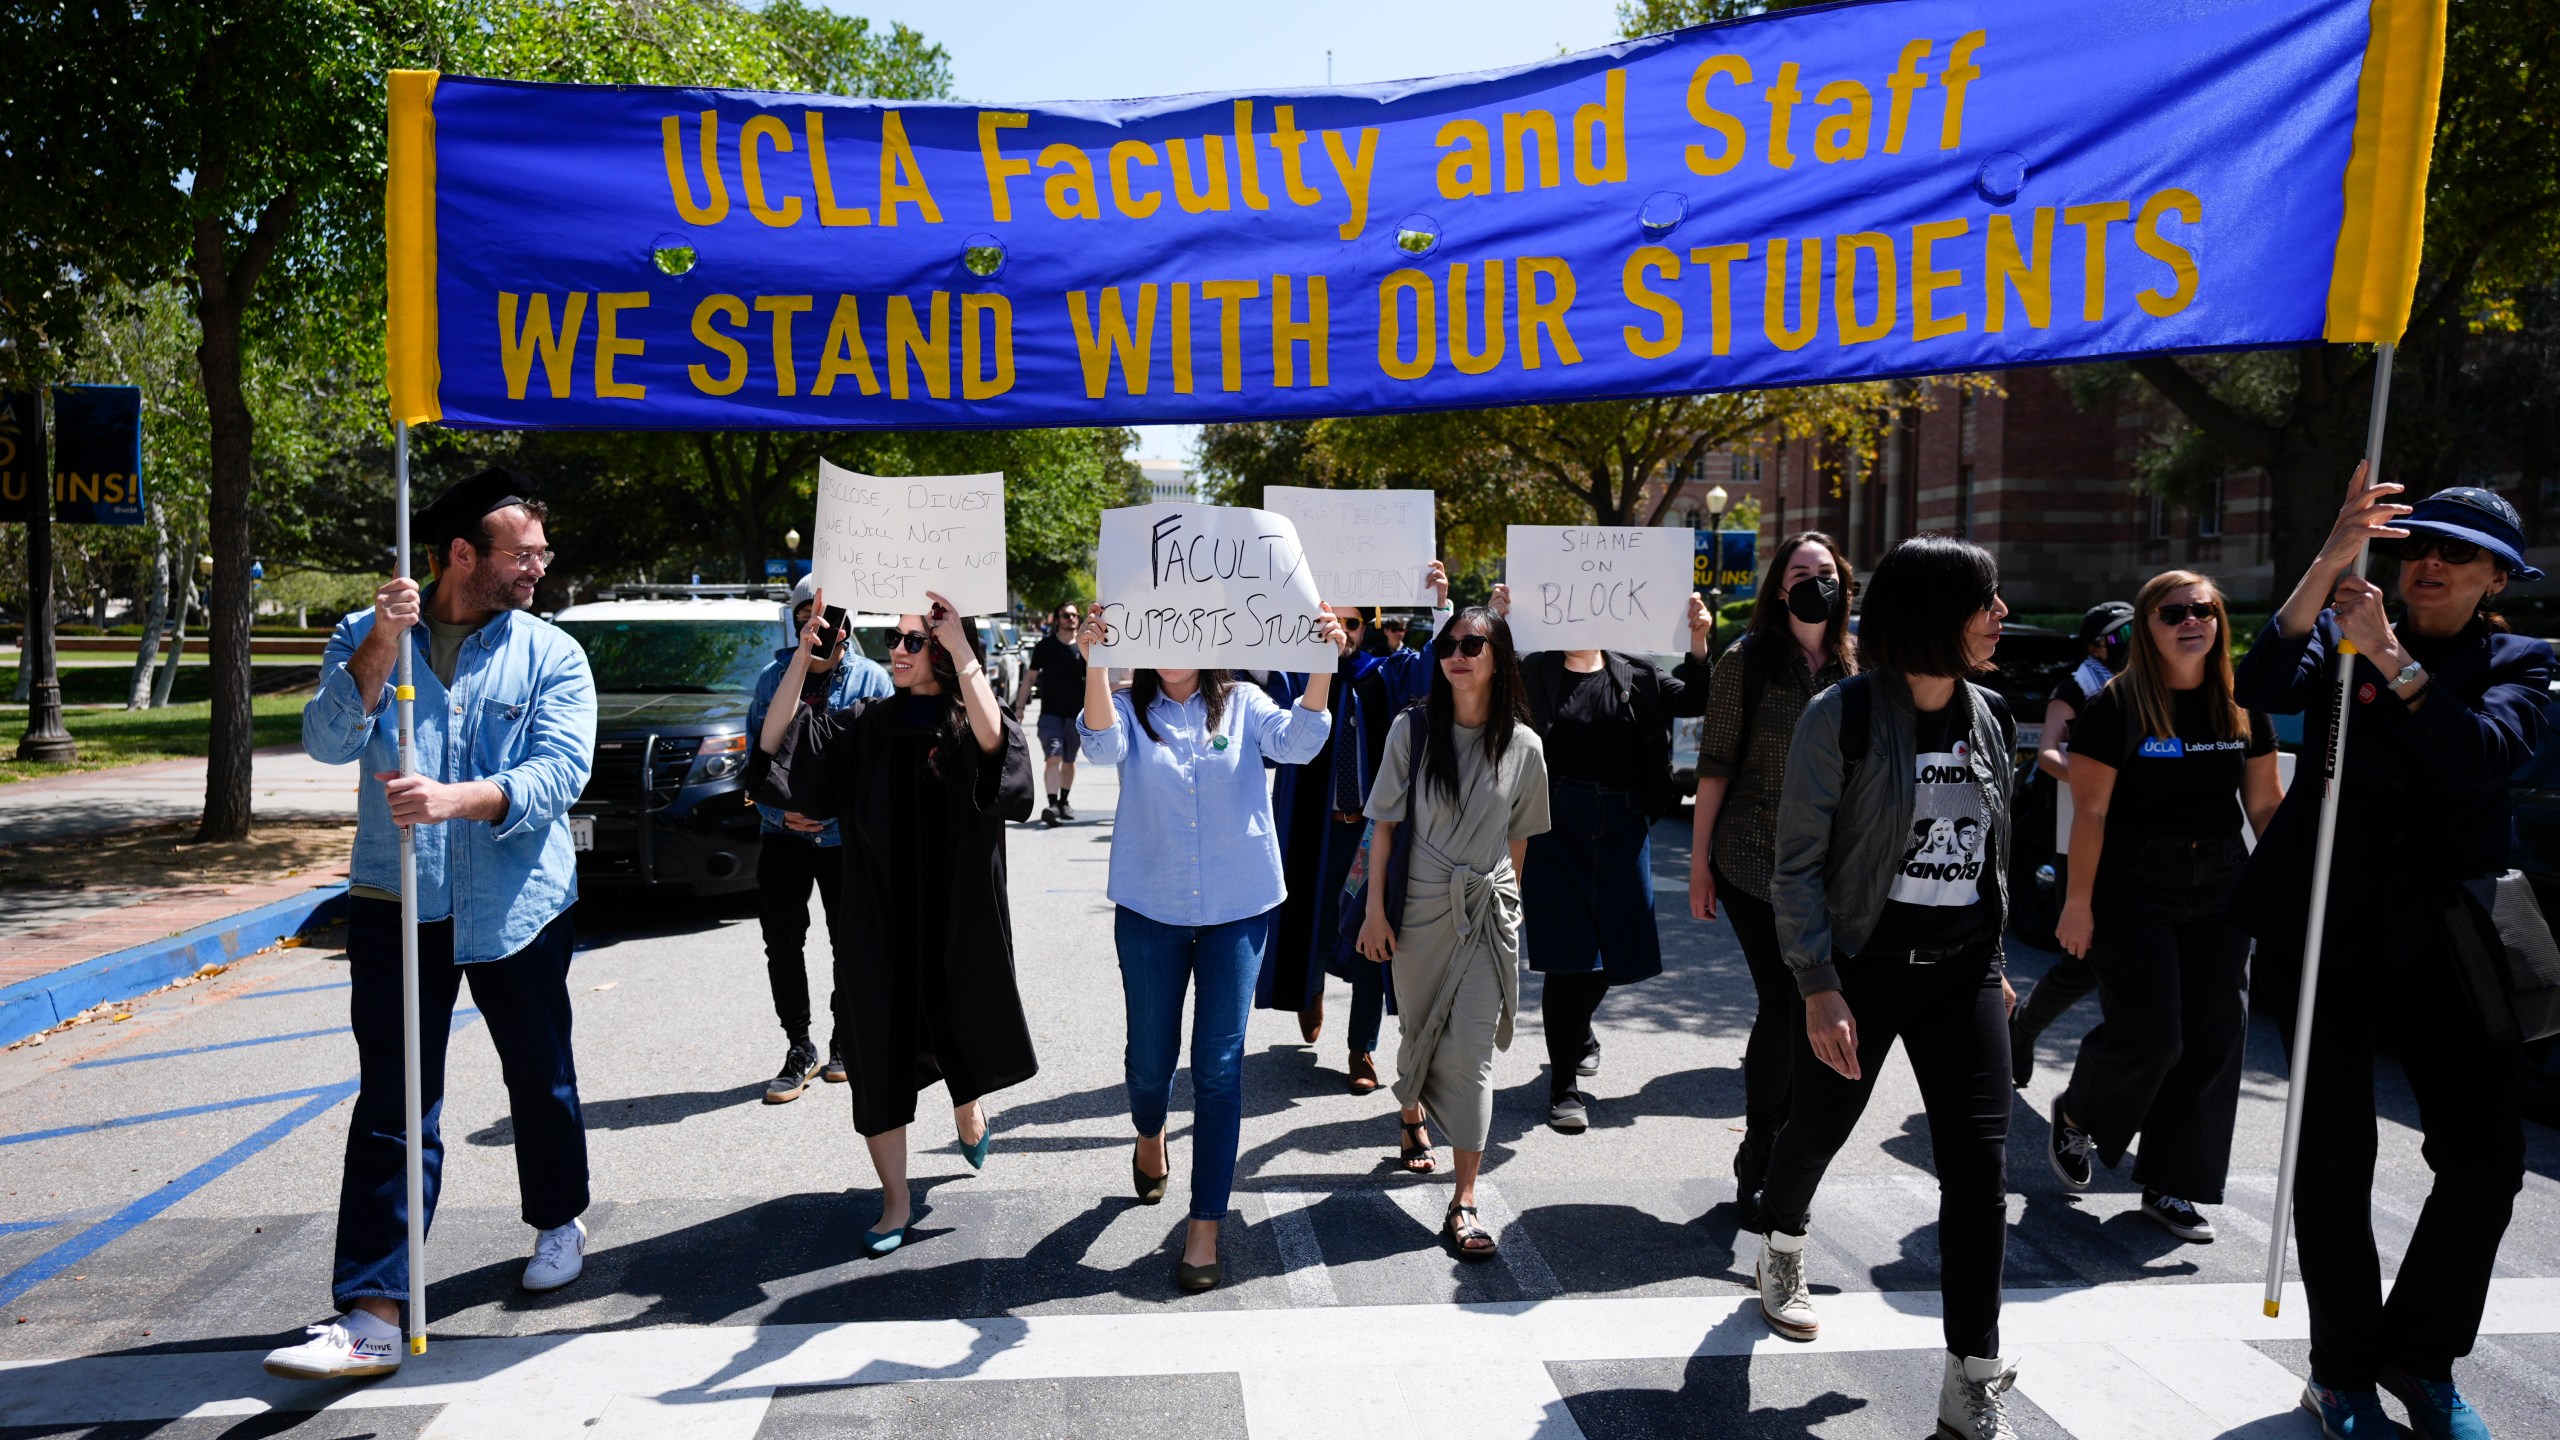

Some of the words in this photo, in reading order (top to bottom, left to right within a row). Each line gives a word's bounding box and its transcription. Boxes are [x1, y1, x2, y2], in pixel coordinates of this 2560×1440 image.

[662, 110, 943, 228] UCLA
[979, 100, 1380, 240] Faculty
[1436, 69, 1627, 200] and
[1686, 29, 1986, 176] Staff
[499, 291, 650, 401] WE
[688, 291, 1015, 401] STAND
[1067, 274, 1329, 399] WITH
[1378, 256, 1583, 380] OUR
[1624, 188, 2202, 359] STUDENTS
[907, 485, 999, 511] DIVEST
[1282, 494, 1412, 526] PROTECT
[825, 508, 842, 534] WE
[849, 515, 894, 540] WILL
[908, 523, 966, 543] NOT
[1152, 514, 1304, 589] FACULTY
[1313, 531, 1376, 555] OUR
[1561, 529, 1643, 551] SHAME
[838, 544, 864, 566] WE
[877, 552, 949, 571] WILL
[964, 551, 1002, 569] NOT
[1581, 560, 1613, 572] ON
[1694, 554, 1709, 570] O
[852, 568, 917, 598] REST
[1312, 564, 1437, 600] TUDENTS
[1693, 571, 1713, 585] RU
[1539, 577, 1650, 625] BLOCK
[1100, 602, 1236, 652] SUPPORTS
[1245, 593, 1328, 648] STUDE
[2144, 741, 2177, 753] UCLA
[2185, 742, 2215, 752] Labor
[573, 831, 588, 846] 11
[1896, 860, 1982, 883] BLONDI
